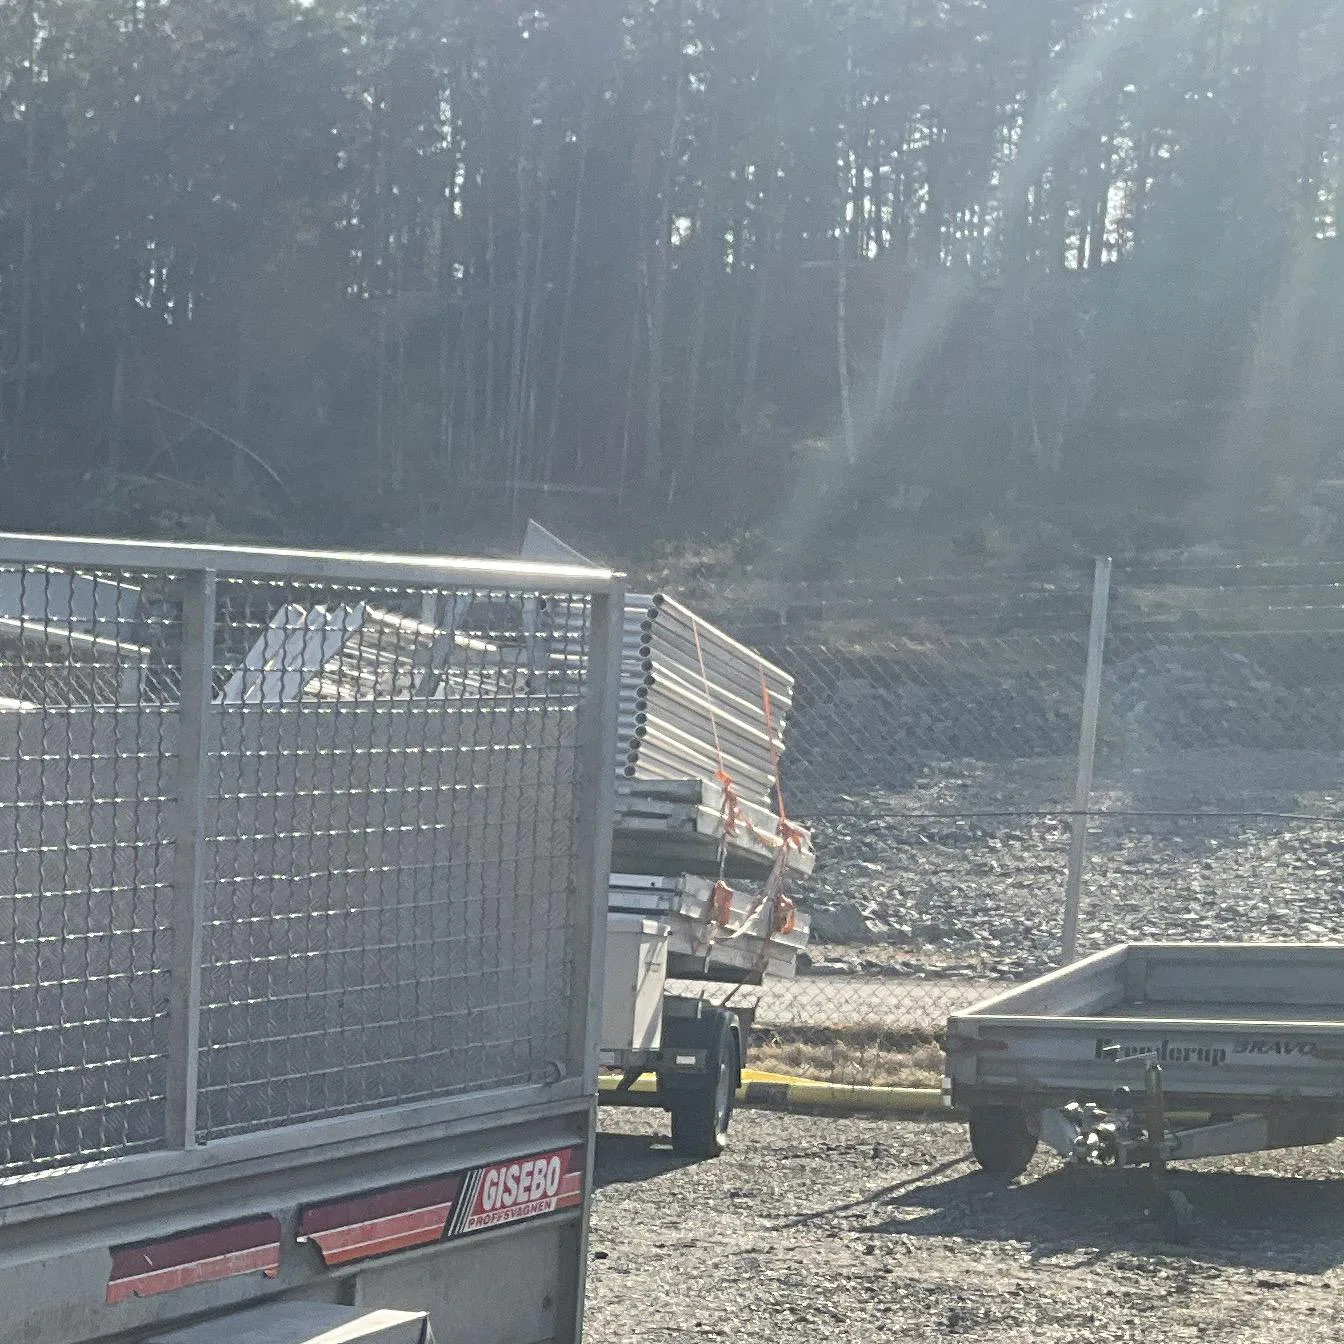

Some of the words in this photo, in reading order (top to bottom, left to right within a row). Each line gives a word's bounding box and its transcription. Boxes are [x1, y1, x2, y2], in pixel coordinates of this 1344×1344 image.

[1232, 1040, 1318, 1054] BRAVO
[482, 1156, 561, 1210] GISEBO
[468, 1201, 552, 1228] PROFFSVAGNEN
